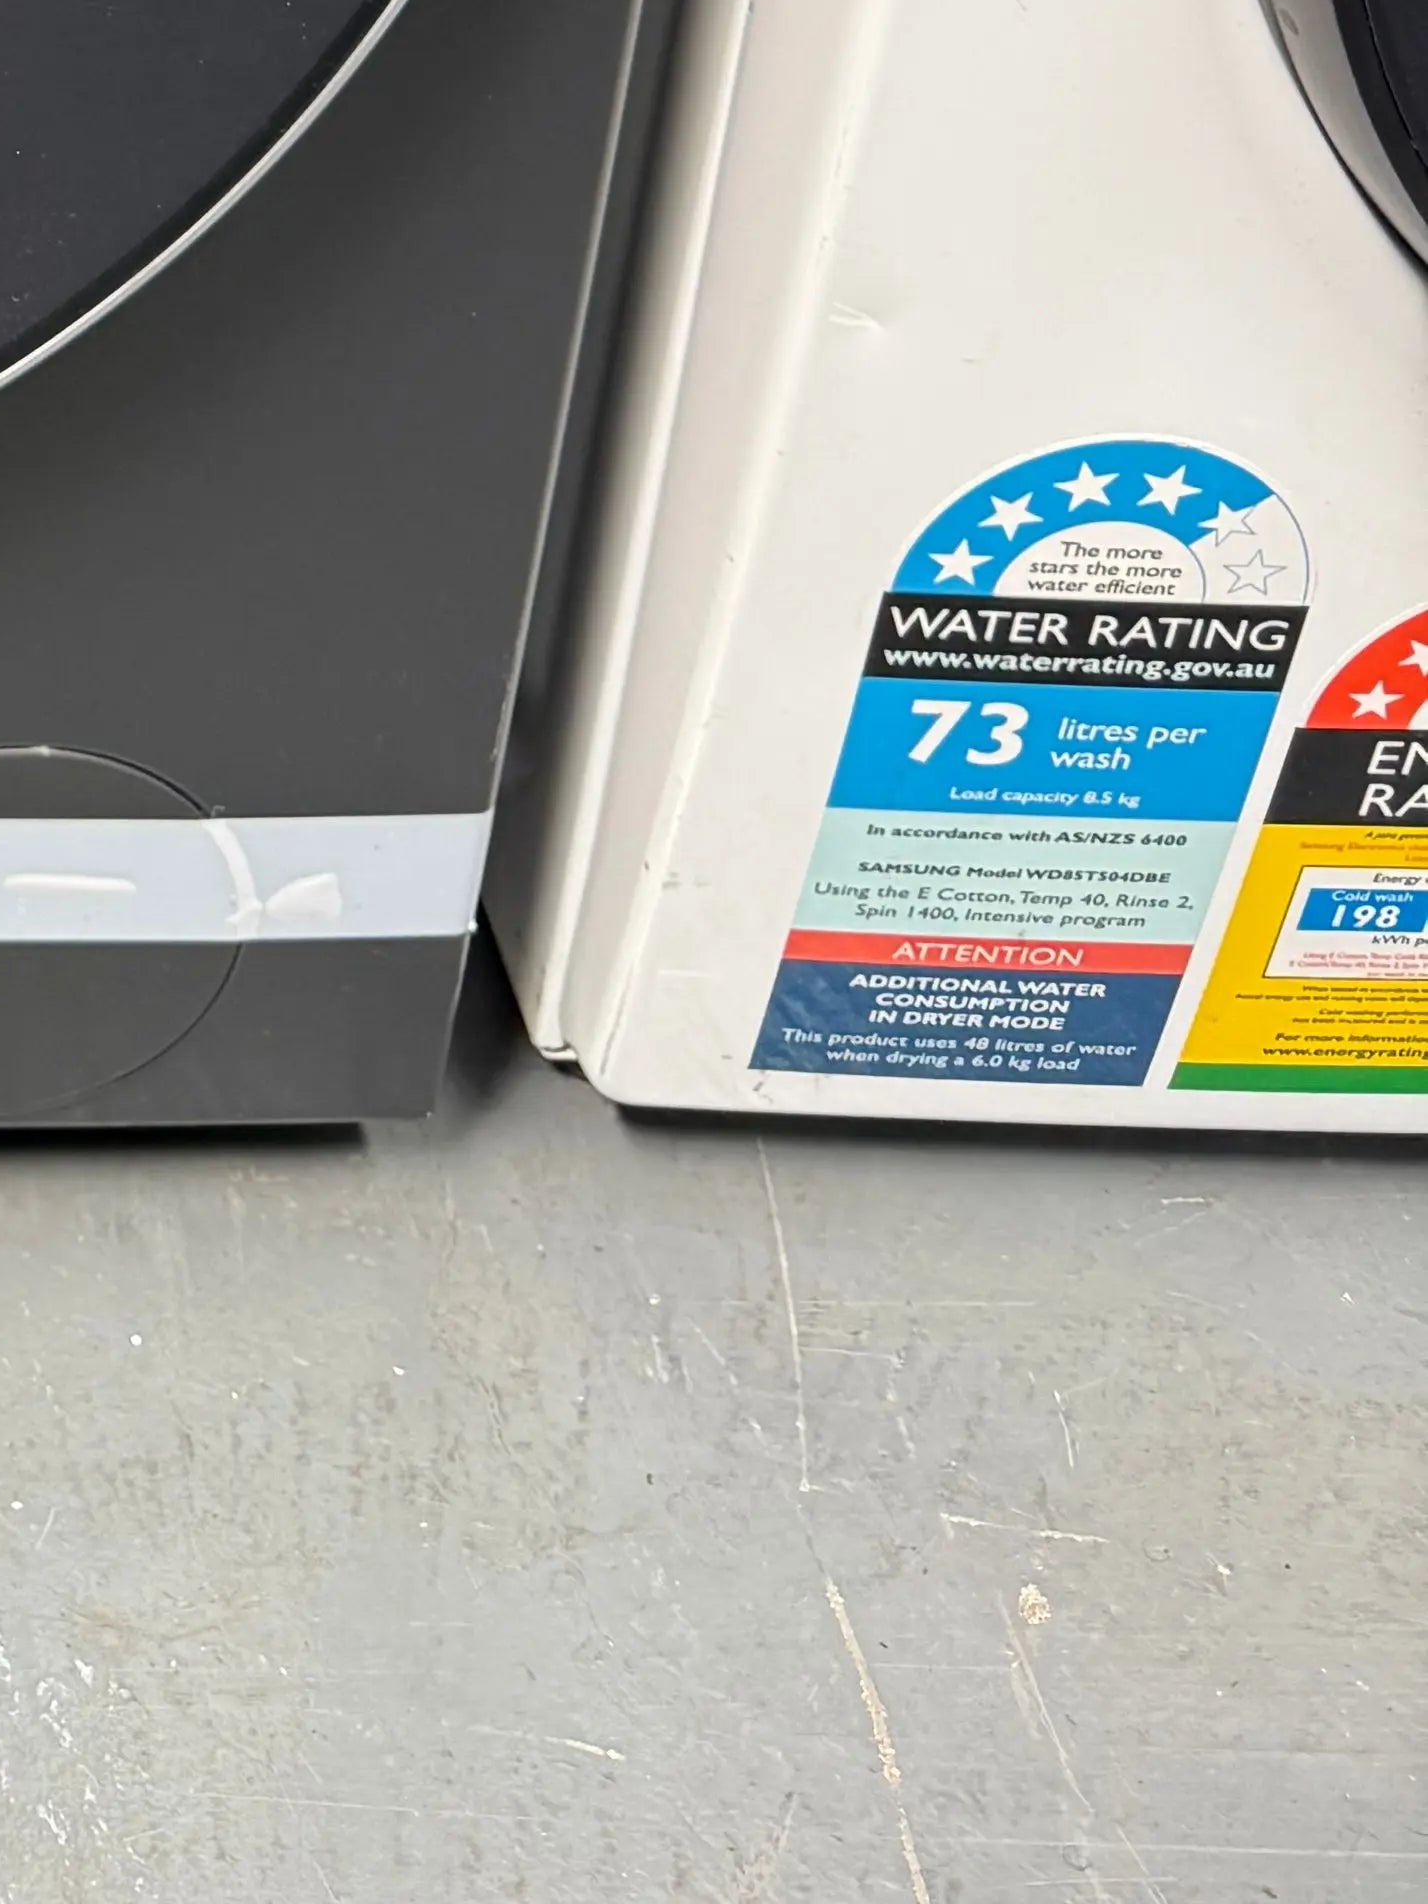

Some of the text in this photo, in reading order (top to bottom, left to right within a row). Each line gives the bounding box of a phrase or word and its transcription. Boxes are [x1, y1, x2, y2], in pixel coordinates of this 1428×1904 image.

[1061, 541, 1163, 560] The more
[1029, 562, 1182, 579] stars the more
[1028, 580, 1176, 596] water efficient
[890, 606, 1290, 652] WATER RATING
[883, 648, 1276, 682] www.waterrating.gov.au
[908, 699, 1207, 765] 73 litres per
[1050, 748, 1131, 771] wash
[949, 786, 1079, 806] Load capacity
[891, 825, 1187, 846] accordance with AS/NZS 6400
[858, 861, 961, 876] SAMSUNG
[967, 865, 1022, 879] Model
[1373, 872, 1422, 885] Energy
[814, 882, 1170, 908] Using the E Cotton, Temp Rinse
[1331, 890, 1413, 903] Cold wash
[855, 904, 1146, 928] Spin Intensive program
[1331, 904, 1401, 928] 198
[1371, 935, 1411, 946] kWh
[892, 941, 1084, 967] ATTENTION
[849, 974, 1107, 998] ADDITIONAL WATER
[875, 993, 1070, 1013] CONSUMPTION
[869, 1010, 1065, 1031] IN DRYER MODE
[782, 1028, 1137, 1056] This product uses litres of water
[826, 1049, 1081, 1071] when drying 6.0 kg load
